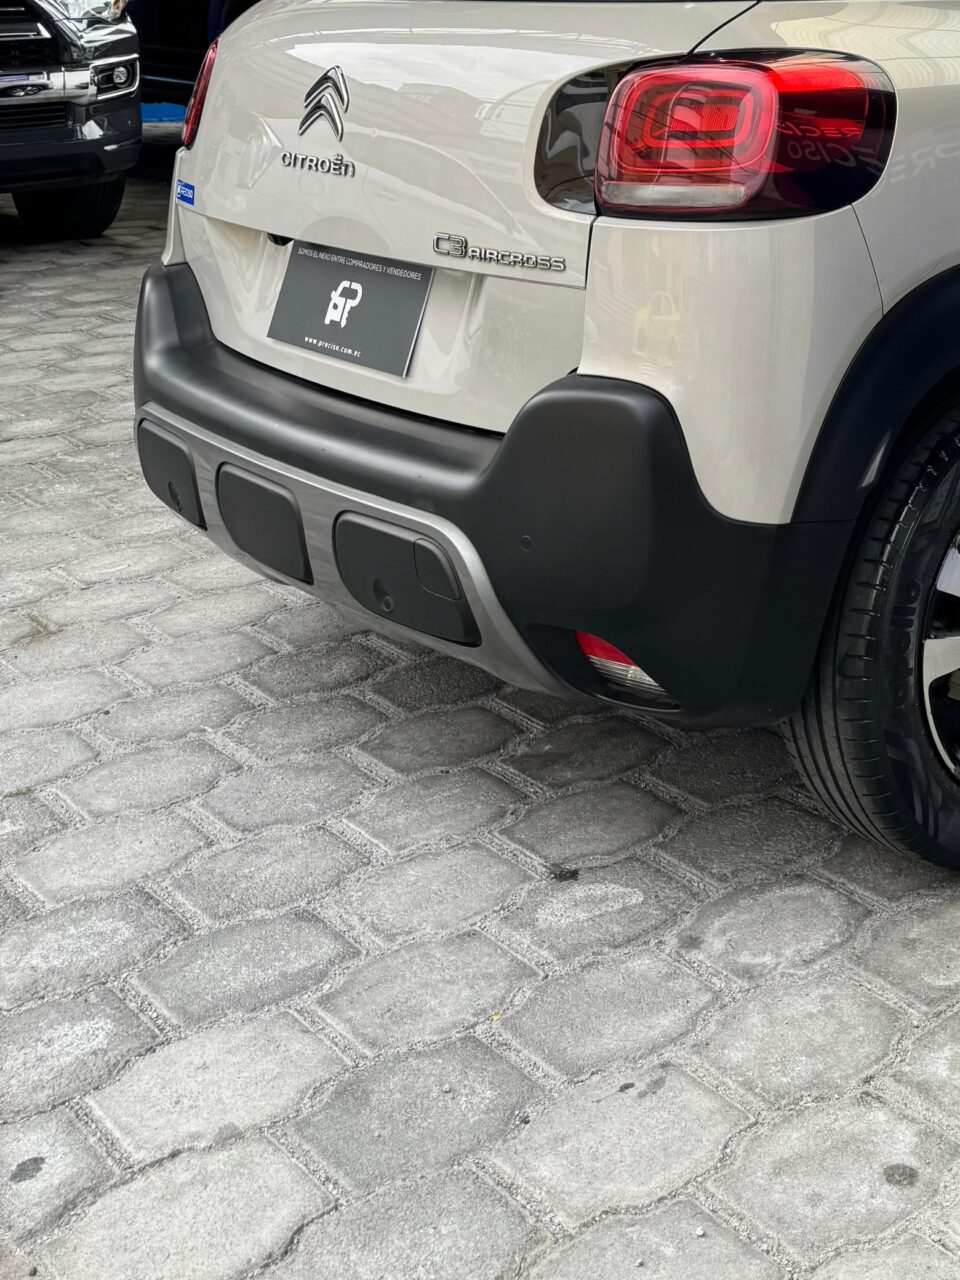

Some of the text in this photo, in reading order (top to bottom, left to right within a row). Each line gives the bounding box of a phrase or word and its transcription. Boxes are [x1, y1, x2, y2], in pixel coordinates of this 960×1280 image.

[346, 257, 382, 272] COMPRADORES
[386, 267, 422, 280] VENDEDORES
[468, 246, 567, 272] AIRCROSS
[304, 335, 362, 358] www.preciso.com.ec
